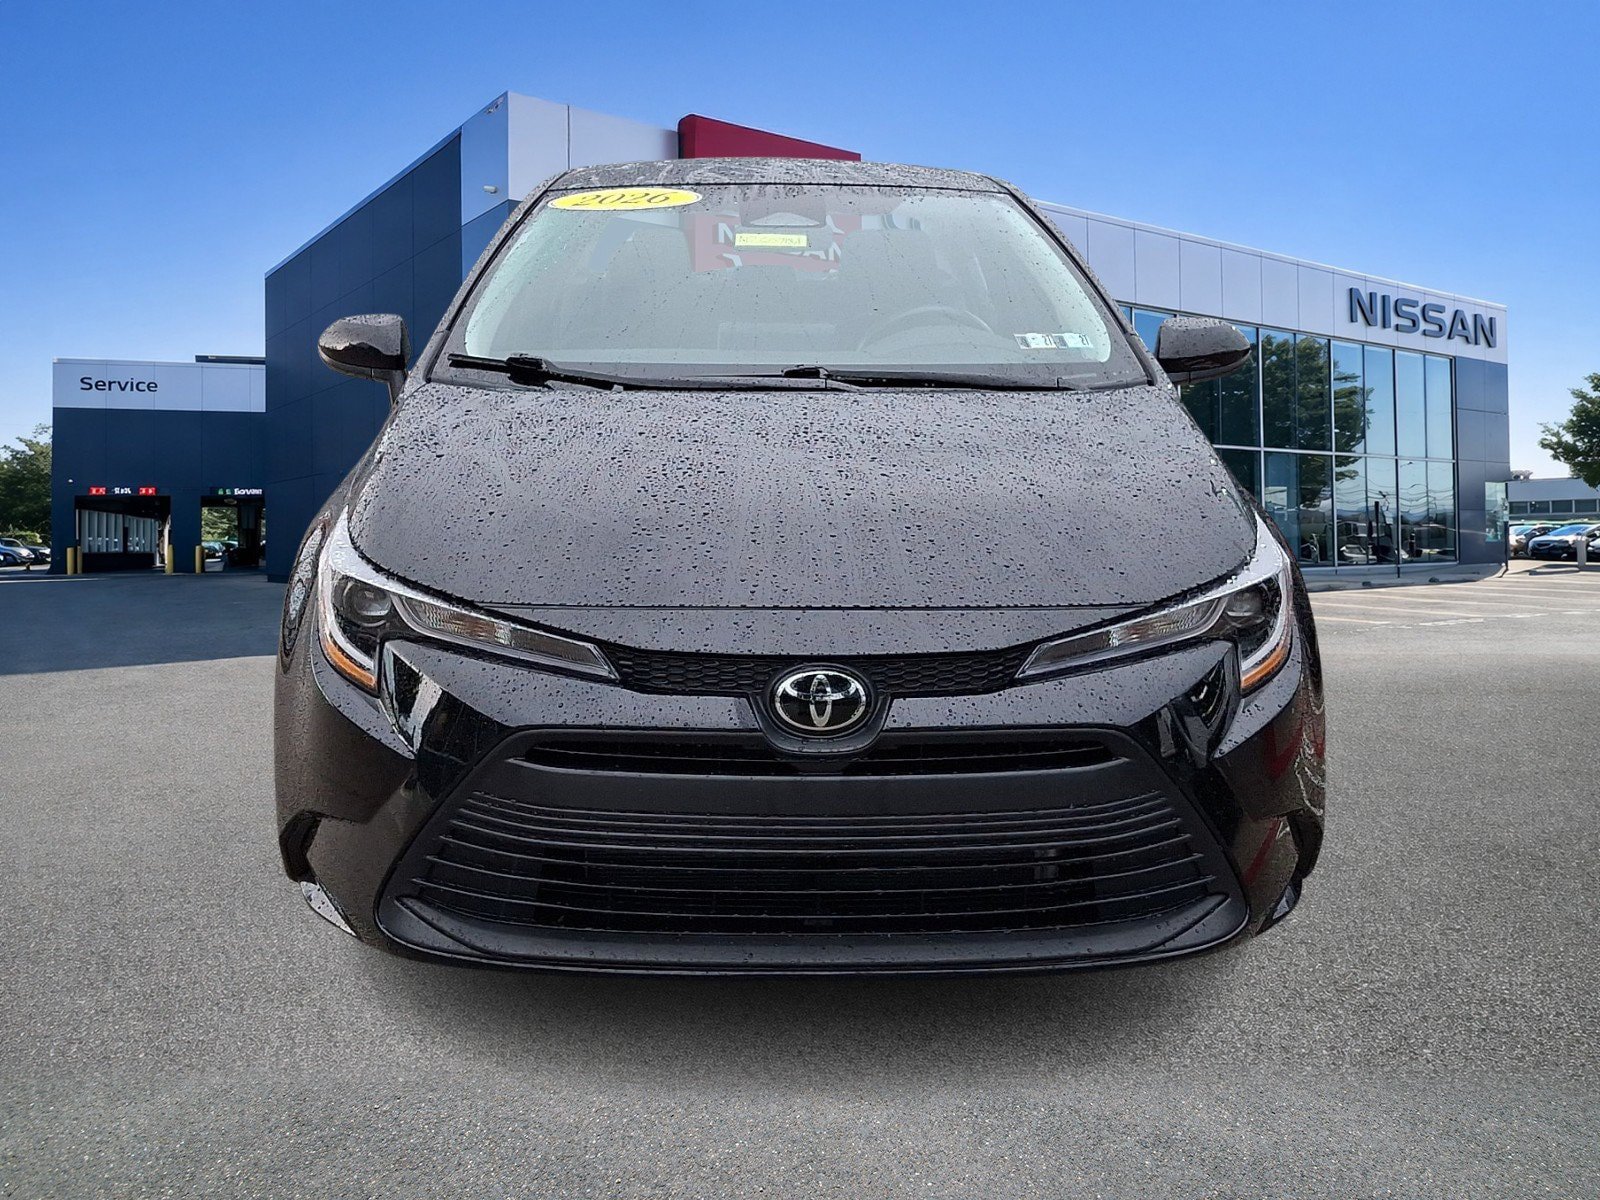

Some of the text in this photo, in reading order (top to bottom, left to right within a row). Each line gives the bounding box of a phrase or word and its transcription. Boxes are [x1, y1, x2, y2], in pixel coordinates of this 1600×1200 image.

[571, 191, 679, 207] 2026
[1348, 287, 1497, 348] NISSAN
[79, 376, 158, 392] Service
